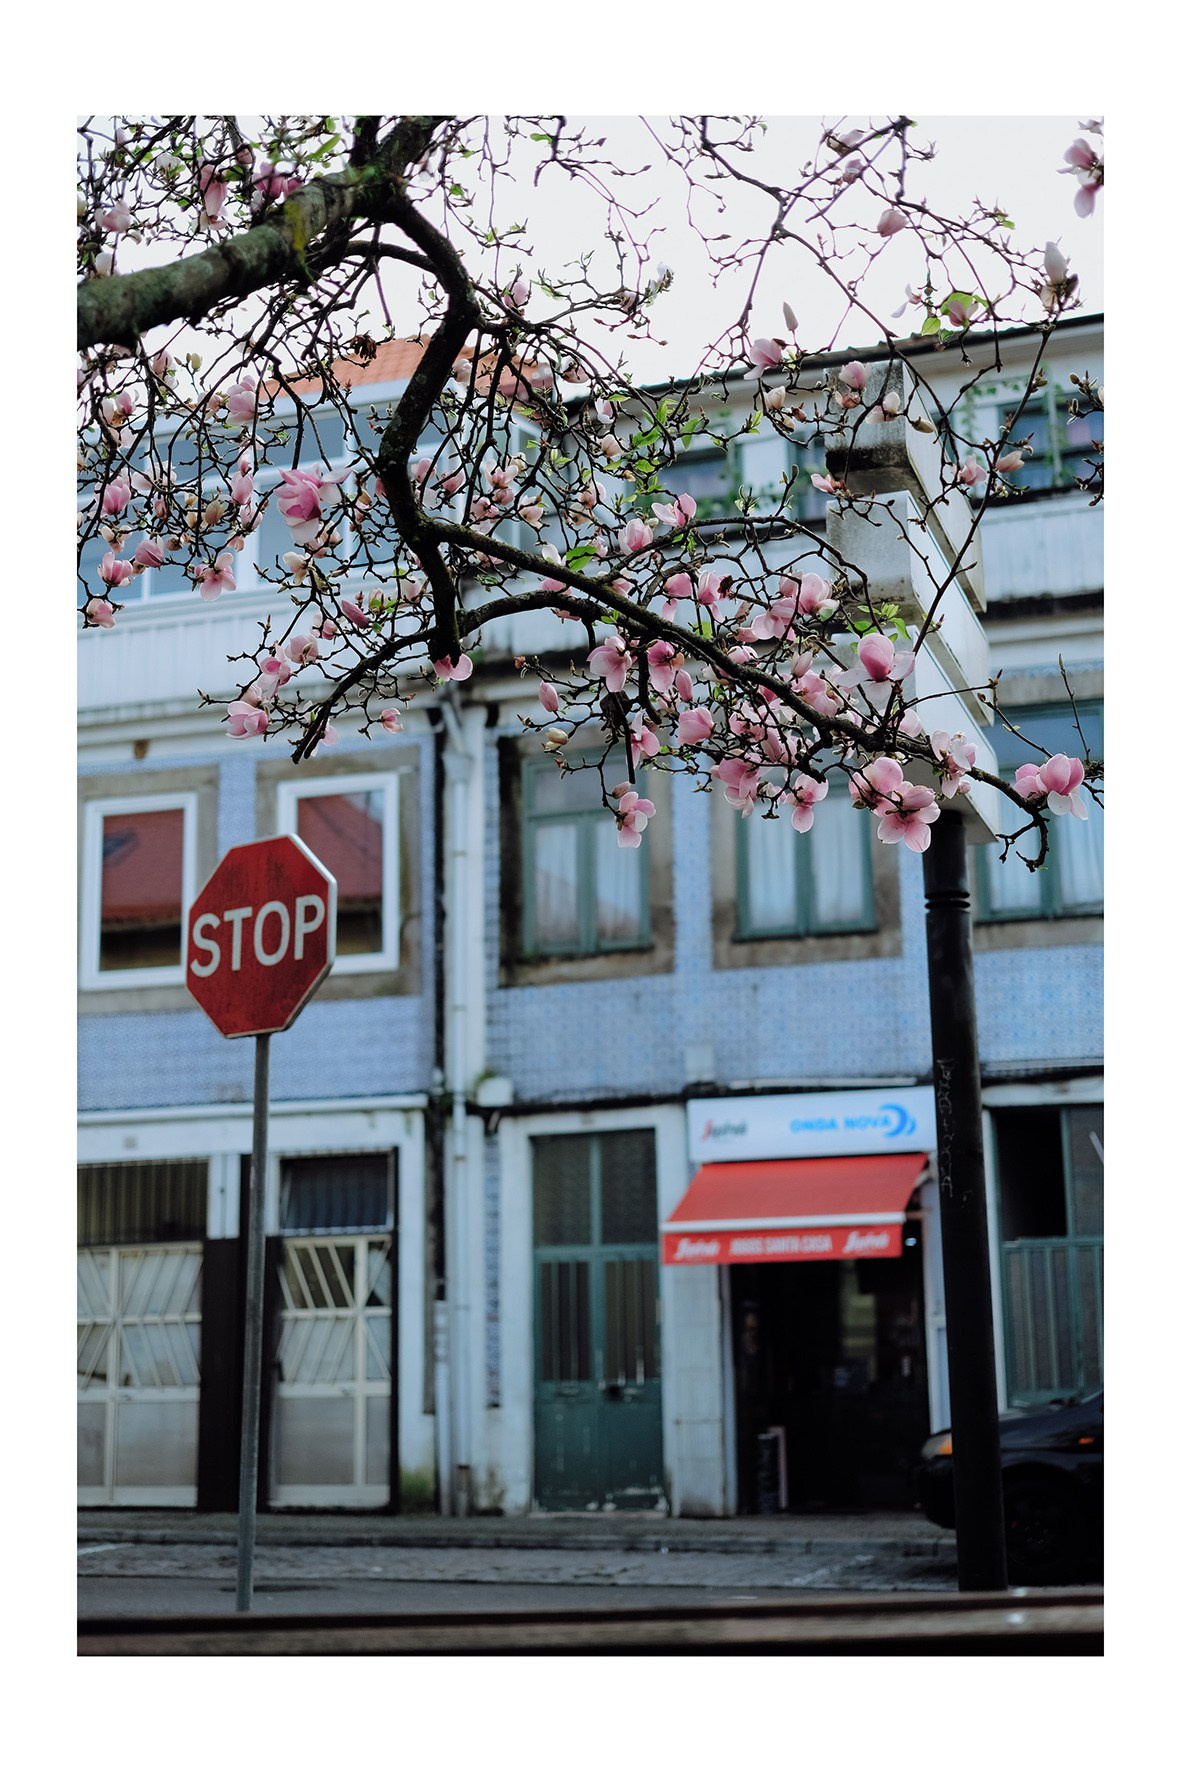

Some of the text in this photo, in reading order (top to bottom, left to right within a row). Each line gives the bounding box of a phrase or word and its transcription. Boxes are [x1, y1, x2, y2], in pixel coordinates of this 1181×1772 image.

[191, 895, 325, 977] STOP
[790, 1115, 892, 1133] ONDA NOVA
[802, 1235, 832, 1253] CASA
